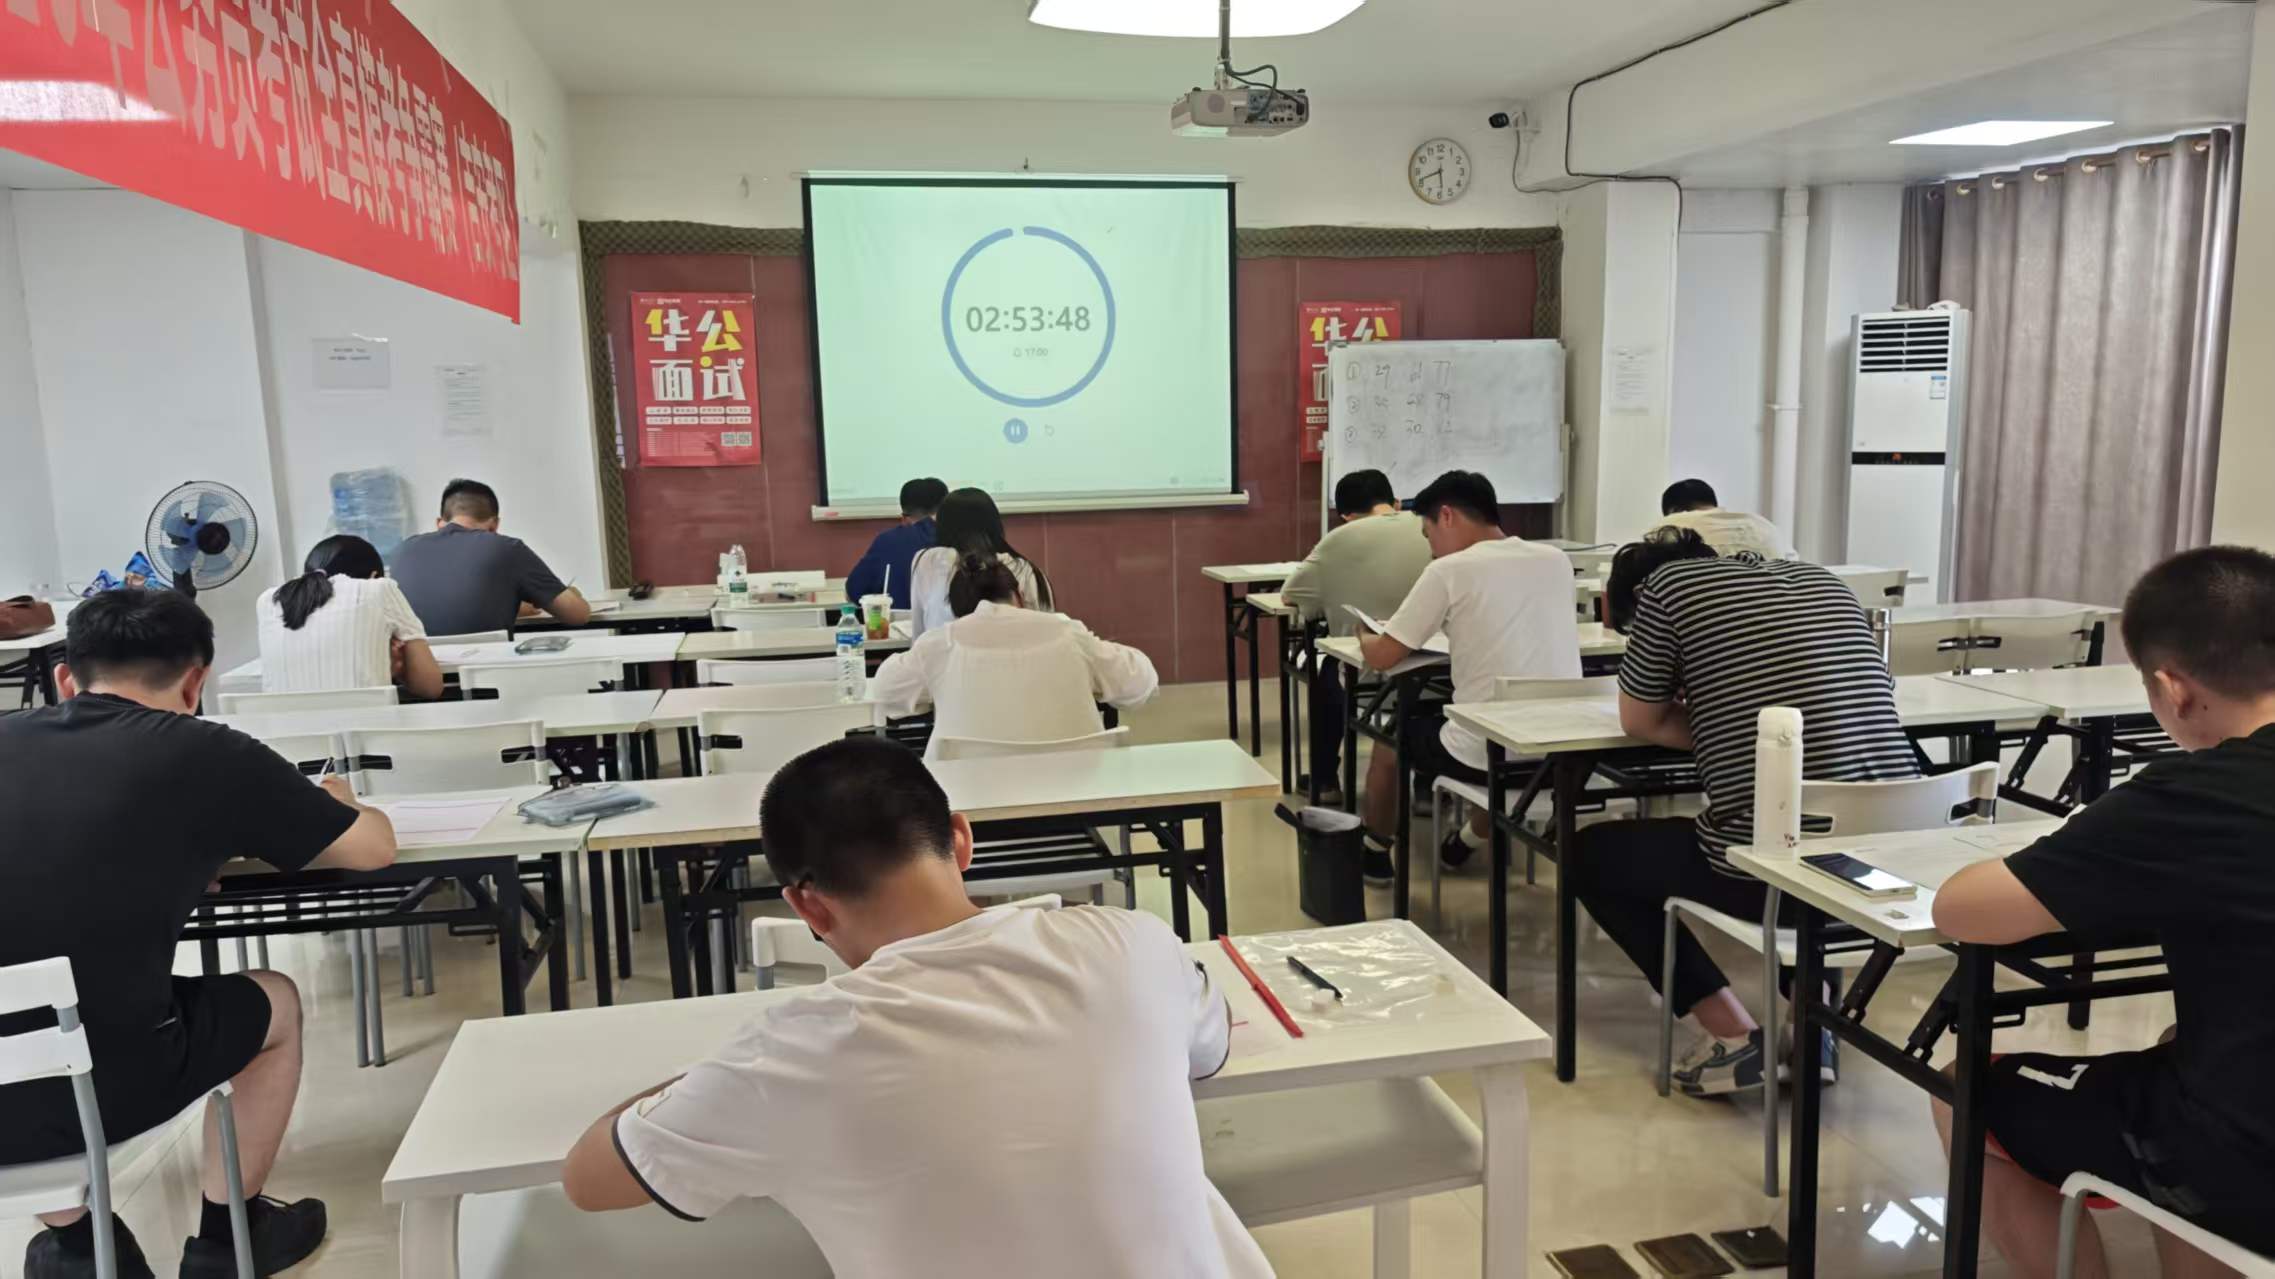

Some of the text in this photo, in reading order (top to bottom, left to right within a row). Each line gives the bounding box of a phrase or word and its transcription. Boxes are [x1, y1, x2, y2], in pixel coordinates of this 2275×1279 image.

[645, 309, 743, 352] 华公
[966, 306, 1090, 332] 02:53:48
[649, 355, 746, 400] 面试
